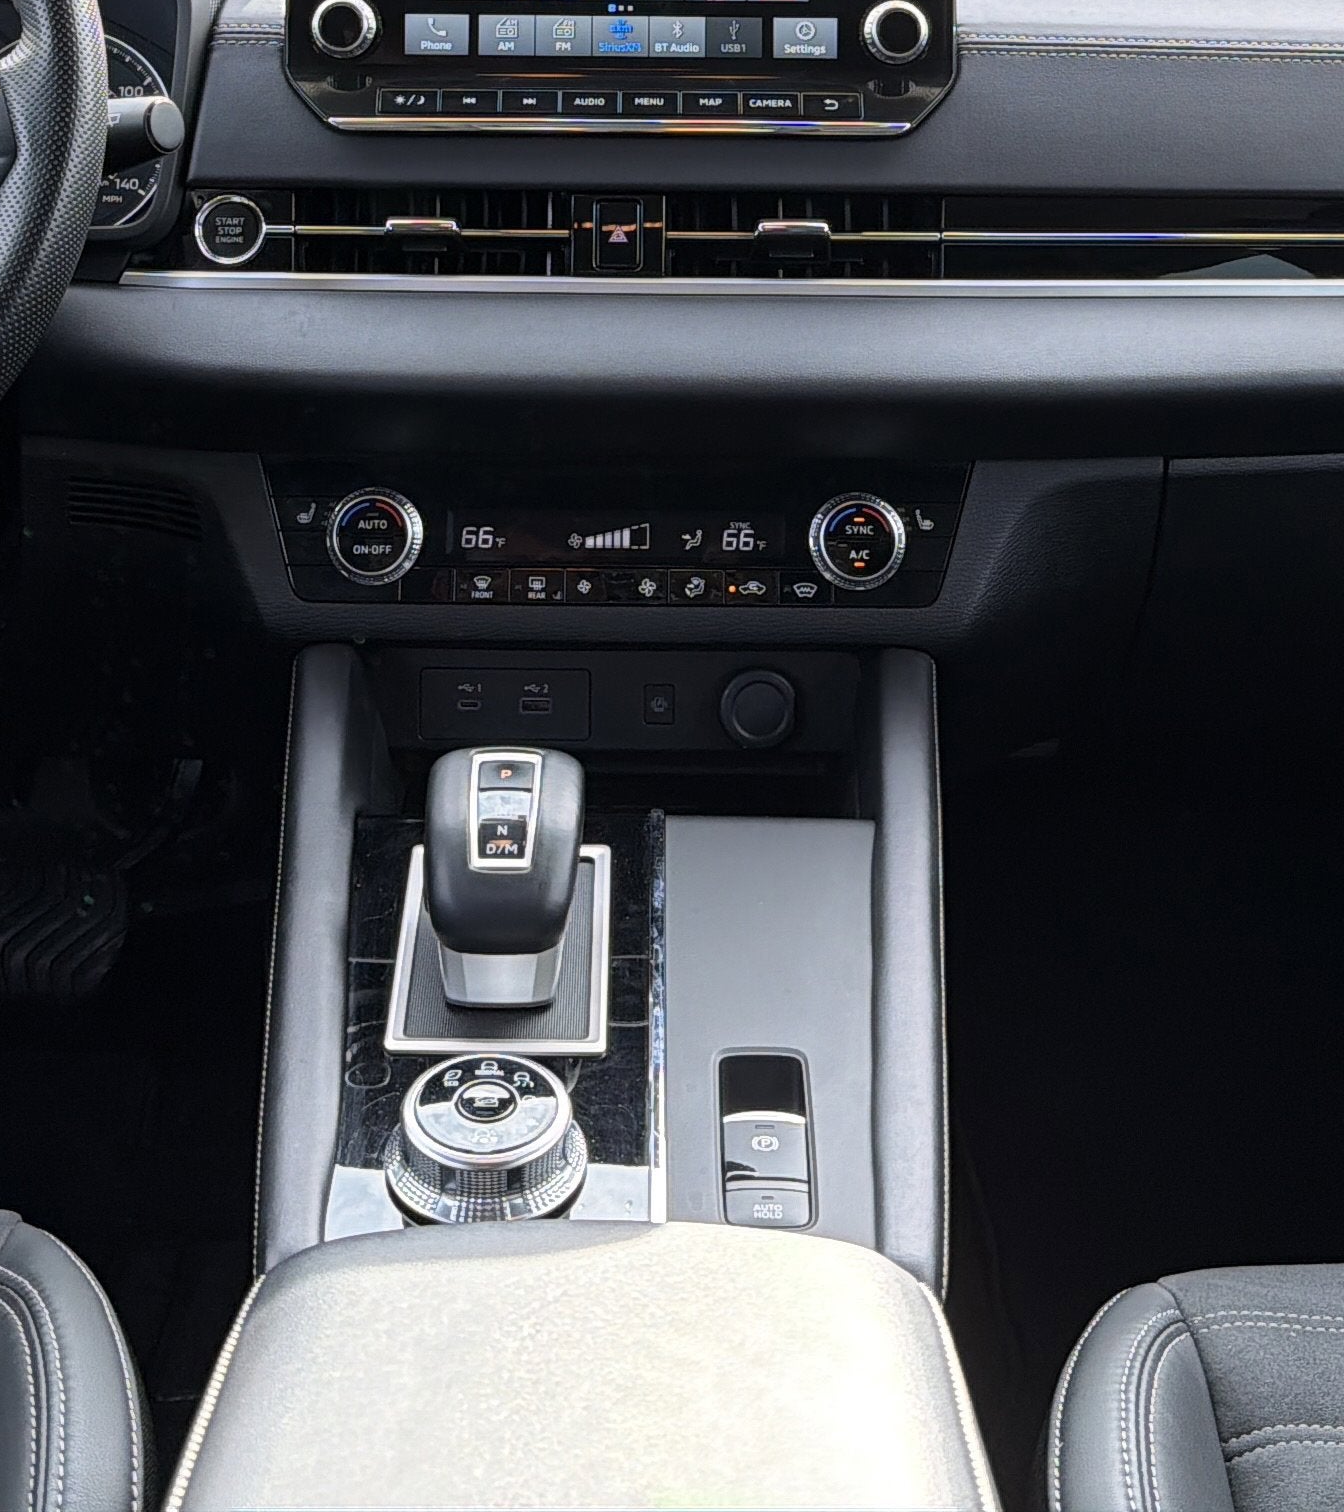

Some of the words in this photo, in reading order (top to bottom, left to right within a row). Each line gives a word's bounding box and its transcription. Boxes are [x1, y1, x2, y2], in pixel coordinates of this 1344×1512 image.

[420, 40, 452, 51] Phone
[497, 42, 515, 51] AM
[555, 42, 572, 51] FM
[598, 42, 642, 52] SiriusXM
[654, 43, 668, 53] BT
[669, 42, 700, 53] Audio
[720, 43, 747, 53] USB1
[783, 43, 827, 56] Settings
[117, 85, 144, 98] 100
[573, 97, 605, 106] AUDIO
[633, 97, 665, 106] MENU
[699, 97, 723, 106] MAP
[748, 98, 793, 108] CAMERA
[113, 177, 139, 191] 140
[102, 195, 123, 204] MPH
[215, 217, 244, 226] START
[217, 226, 243, 235] STOP
[215, 236, 244, 244] ENGINE
[357, 519, 388, 530] AUTO
[729, 521, 752, 529] SYNC
[845, 524, 874, 536] SYNC
[848, 548, 870, 561] A/C
[470, 590, 494, 600] FRONT
[527, 590, 546, 600] REAR
[500, 768, 513, 780] P
[496, 824, 508, 836] N
[485, 843, 519, 856] D/M
[752, 1203, 783, 1212] AUTO
[753, 1210, 783, 1219] HOLD
